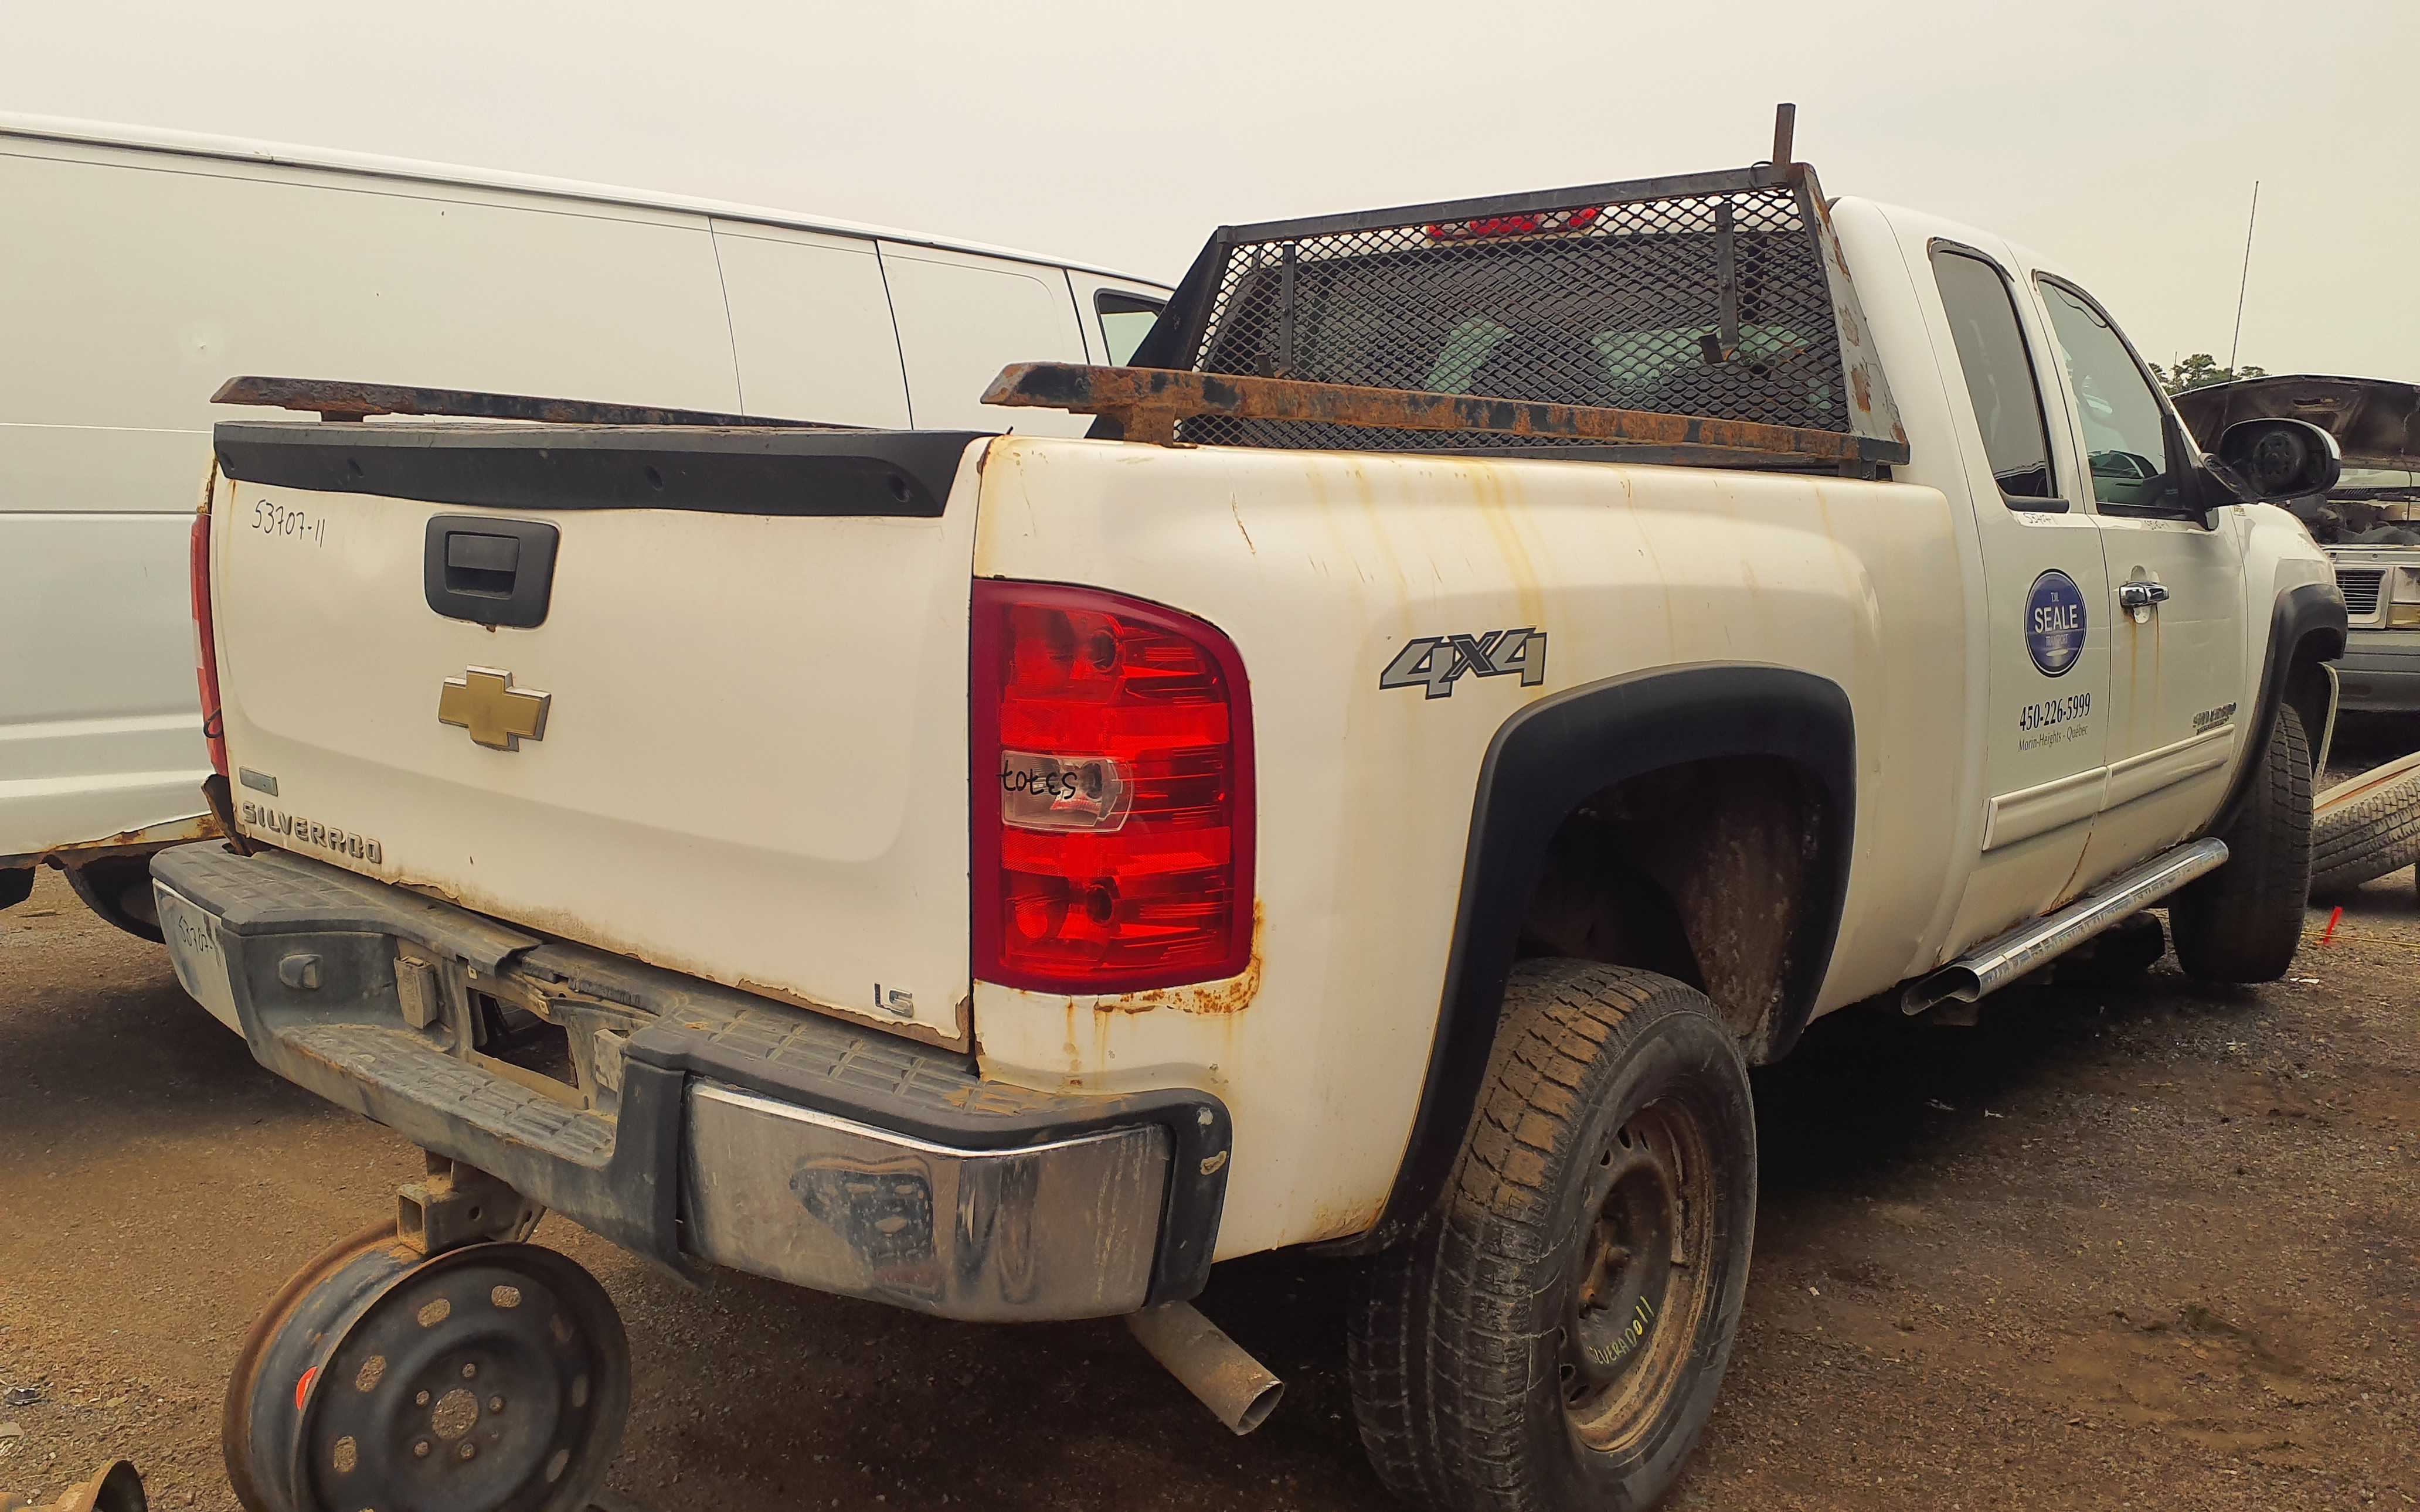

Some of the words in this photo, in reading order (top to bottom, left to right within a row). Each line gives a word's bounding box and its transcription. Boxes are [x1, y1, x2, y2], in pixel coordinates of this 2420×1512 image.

[251, 499, 325, 549] 53707-11
[2034, 604, 2078, 634] SEALE
[2020, 692, 2091, 731] 450-226-5999
[2018, 730, 2062, 752] Morin-Heights
[874, 983, 914, 1019] LS
